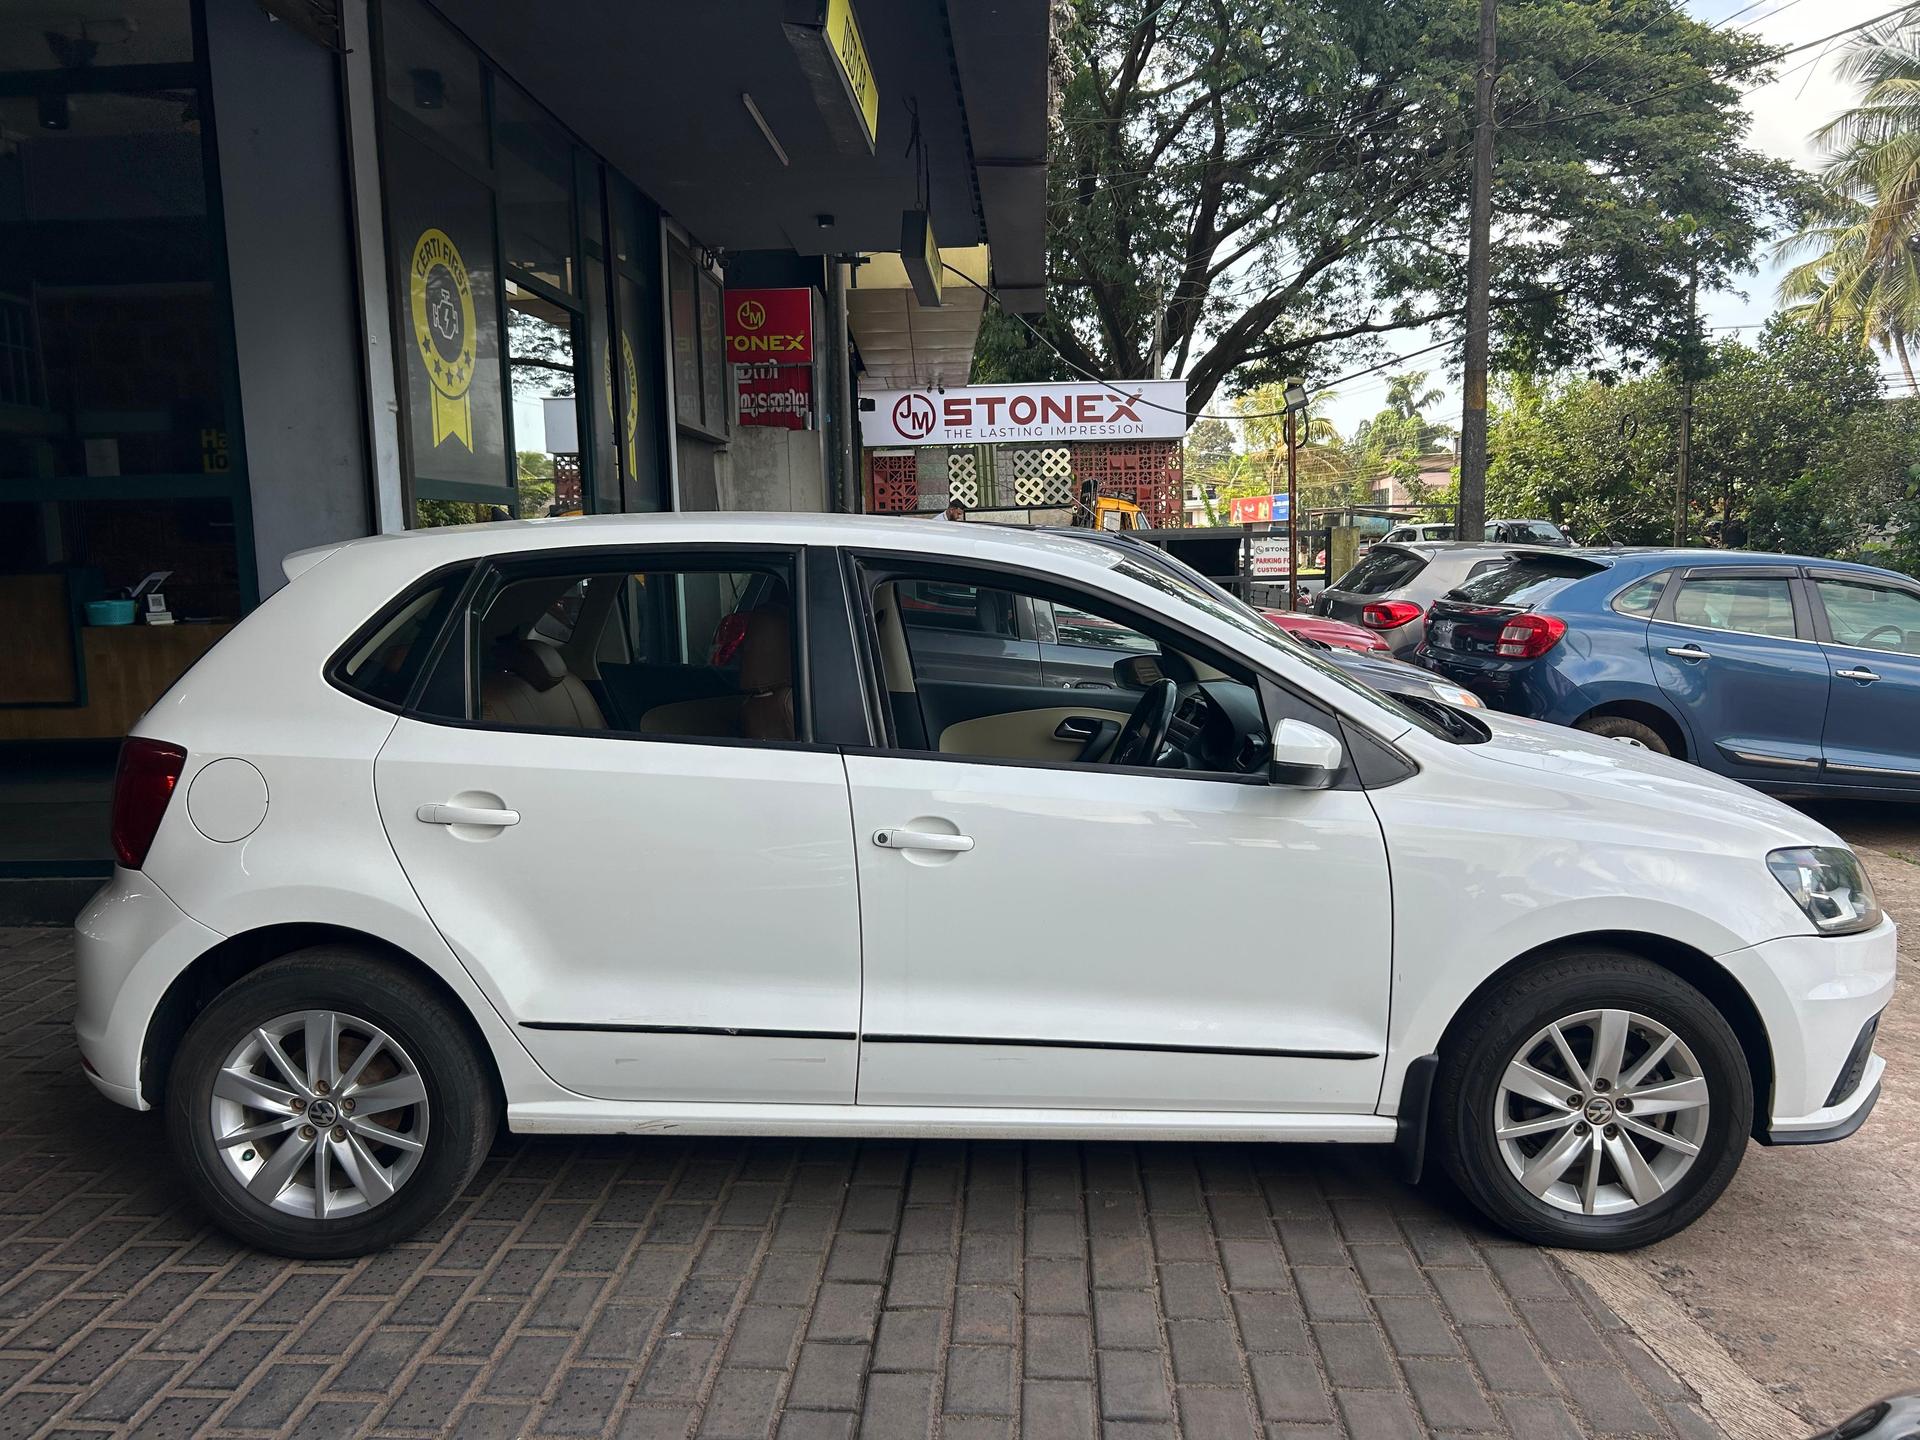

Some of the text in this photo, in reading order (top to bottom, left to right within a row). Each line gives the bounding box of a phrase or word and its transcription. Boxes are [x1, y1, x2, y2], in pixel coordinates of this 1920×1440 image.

[724, 334, 805, 351] TONEX
[943, 393, 1143, 425] STONEX
[944, 424, 1144, 439] THE LASTING IMPRESSION
